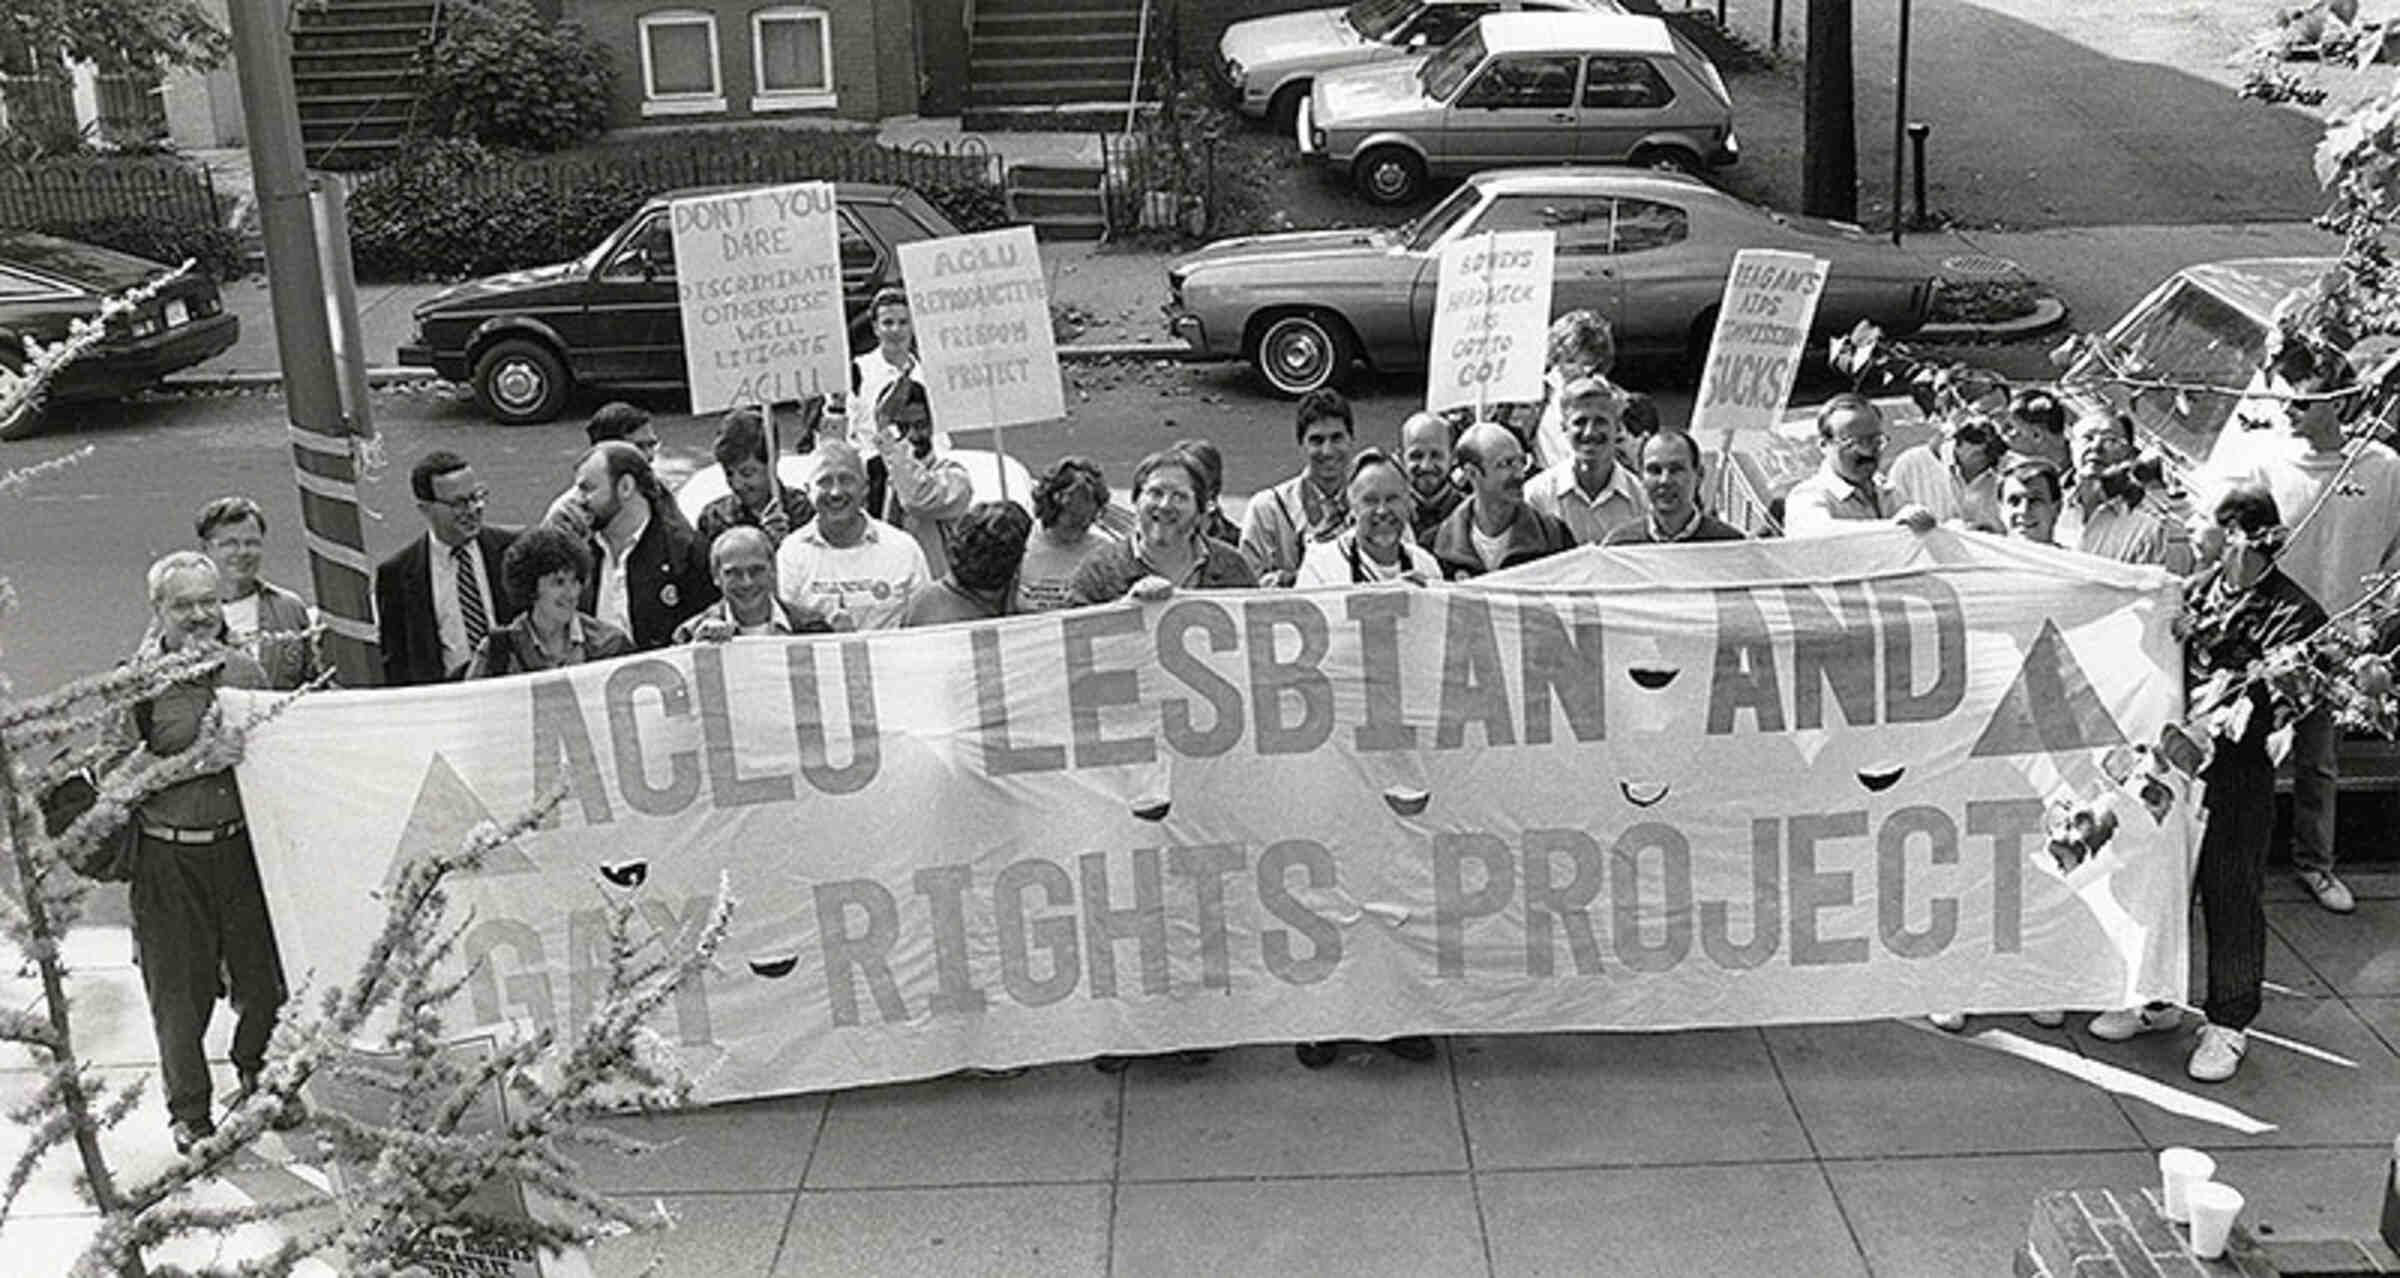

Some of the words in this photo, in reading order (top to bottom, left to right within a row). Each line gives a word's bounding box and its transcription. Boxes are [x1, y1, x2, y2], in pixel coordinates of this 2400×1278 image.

[771, 188, 832, 221] YOU
[722, 227, 790, 262] DARE
[935, 243, 1017, 277] ACLU
[702, 291, 829, 326] OTHERWISE
[715, 335, 828, 369] LITIGATE
[1458, 357, 1507, 388] GO!
[530, 640, 880, 831] ACLU
[971, 591, 1605, 776] LESBIAN
[1706, 576, 1967, 735] AND
[464, 896, 715, 1048] GAY
[811, 838, 1342, 1028] RIGHTS
[1433, 798, 2047, 978] PROJECT
